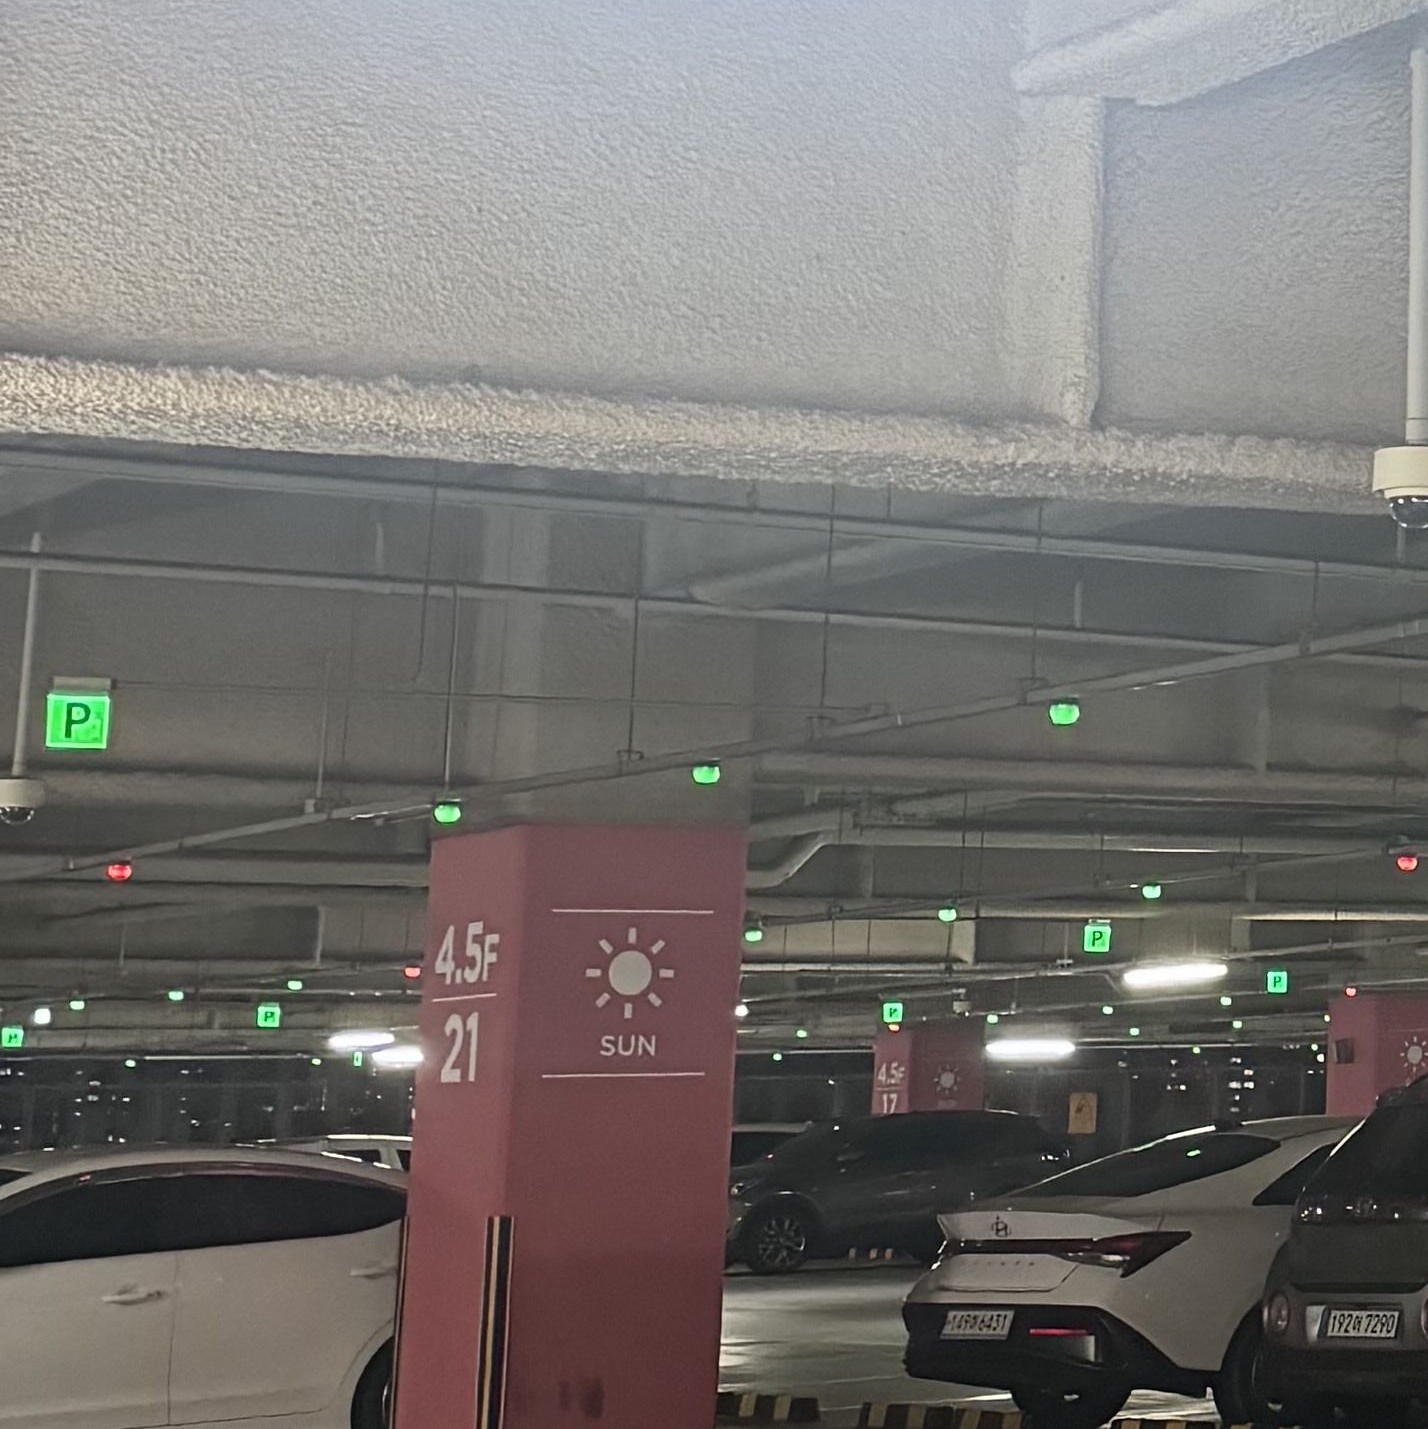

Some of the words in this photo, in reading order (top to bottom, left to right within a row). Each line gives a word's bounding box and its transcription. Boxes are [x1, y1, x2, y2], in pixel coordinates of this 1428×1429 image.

[64, 703, 91, 739] P
[434, 920, 500, 985] 4.5F
[440, 1011, 479, 1083] 21
[599, 1034, 656, 1057] SUN
[881, 1093, 898, 1114] 17
[1364, 1313, 1396, 1334] 7290
